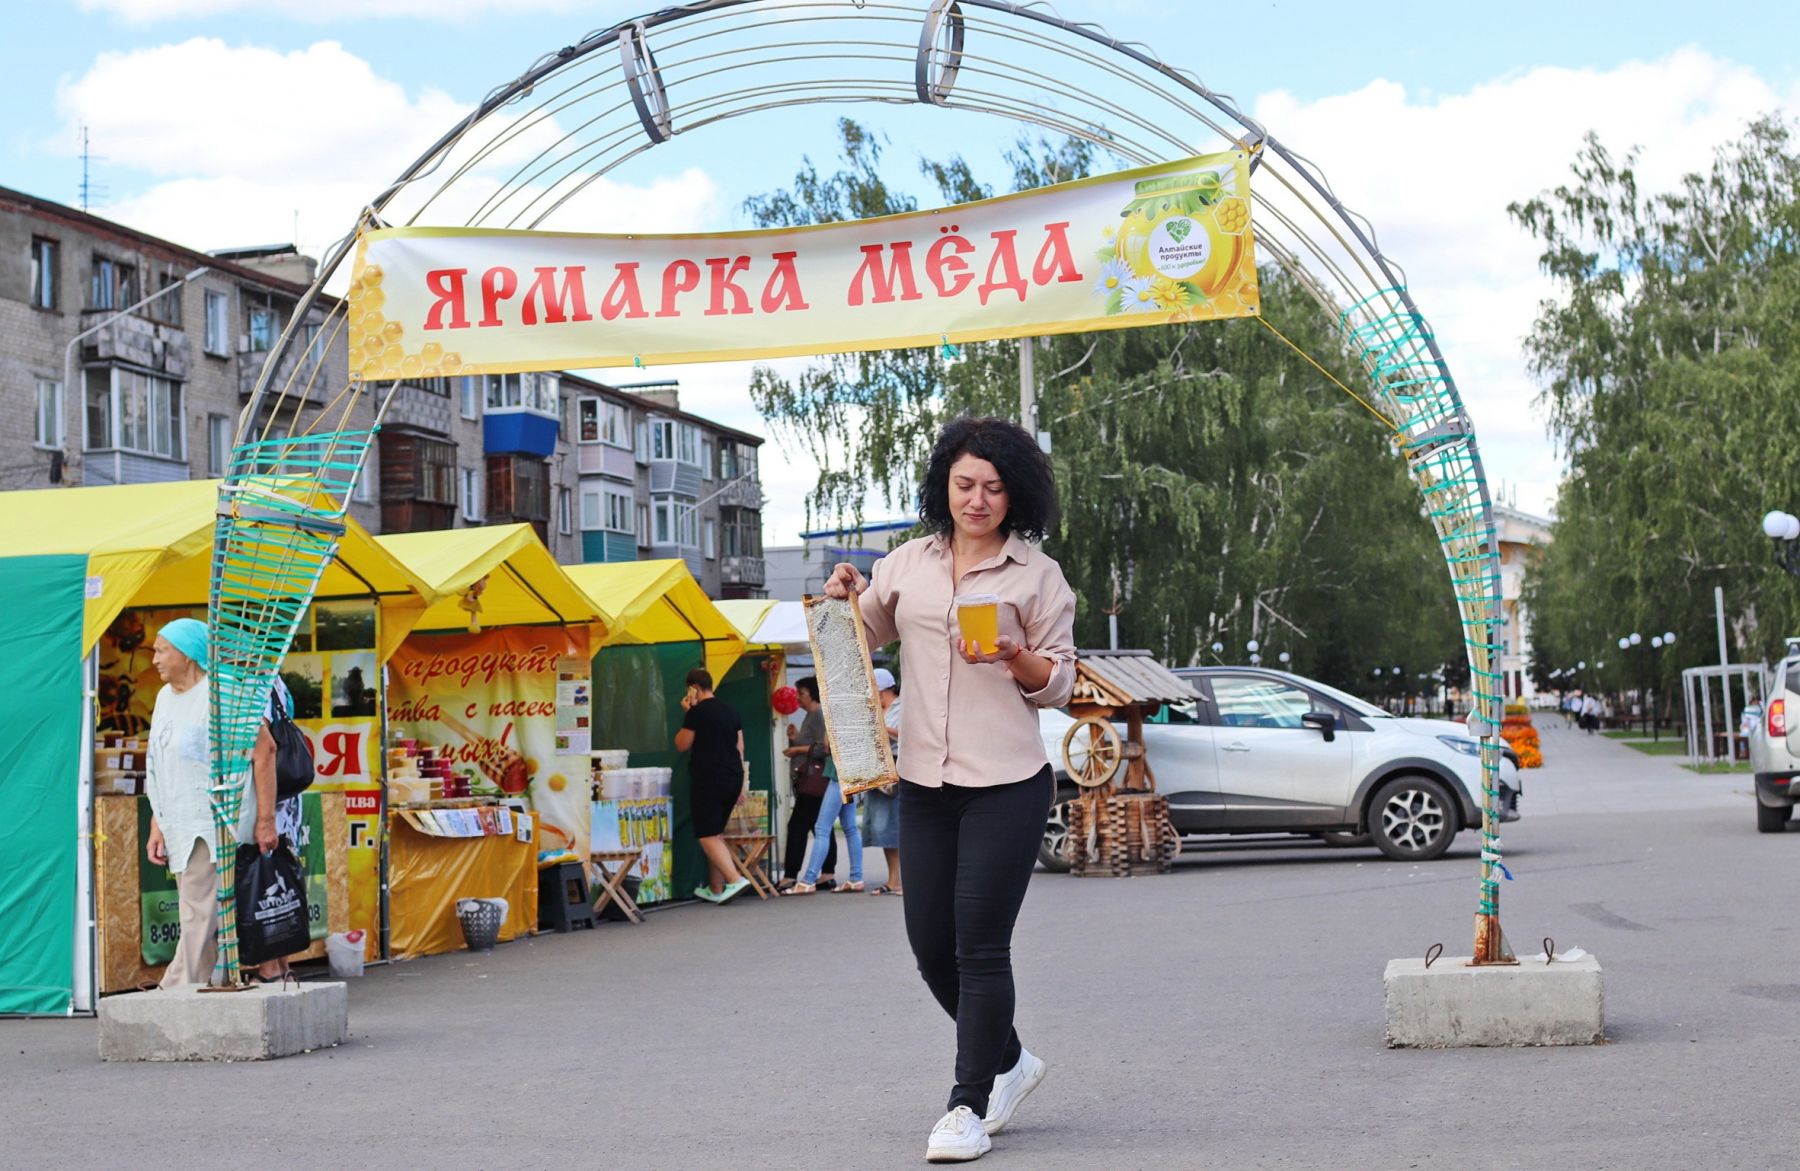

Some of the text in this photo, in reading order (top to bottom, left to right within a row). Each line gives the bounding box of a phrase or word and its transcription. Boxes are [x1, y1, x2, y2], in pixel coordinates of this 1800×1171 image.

[1158, 244, 1203, 254] Алтайские
[1160, 250, 1202, 261] продукты
[423, 221, 1083, 330] ЯРМАРКА МЁДА
[465, 702, 478, 719] с
[488, 700, 557, 718] пасек
[304, 732, 362, 776] Я
